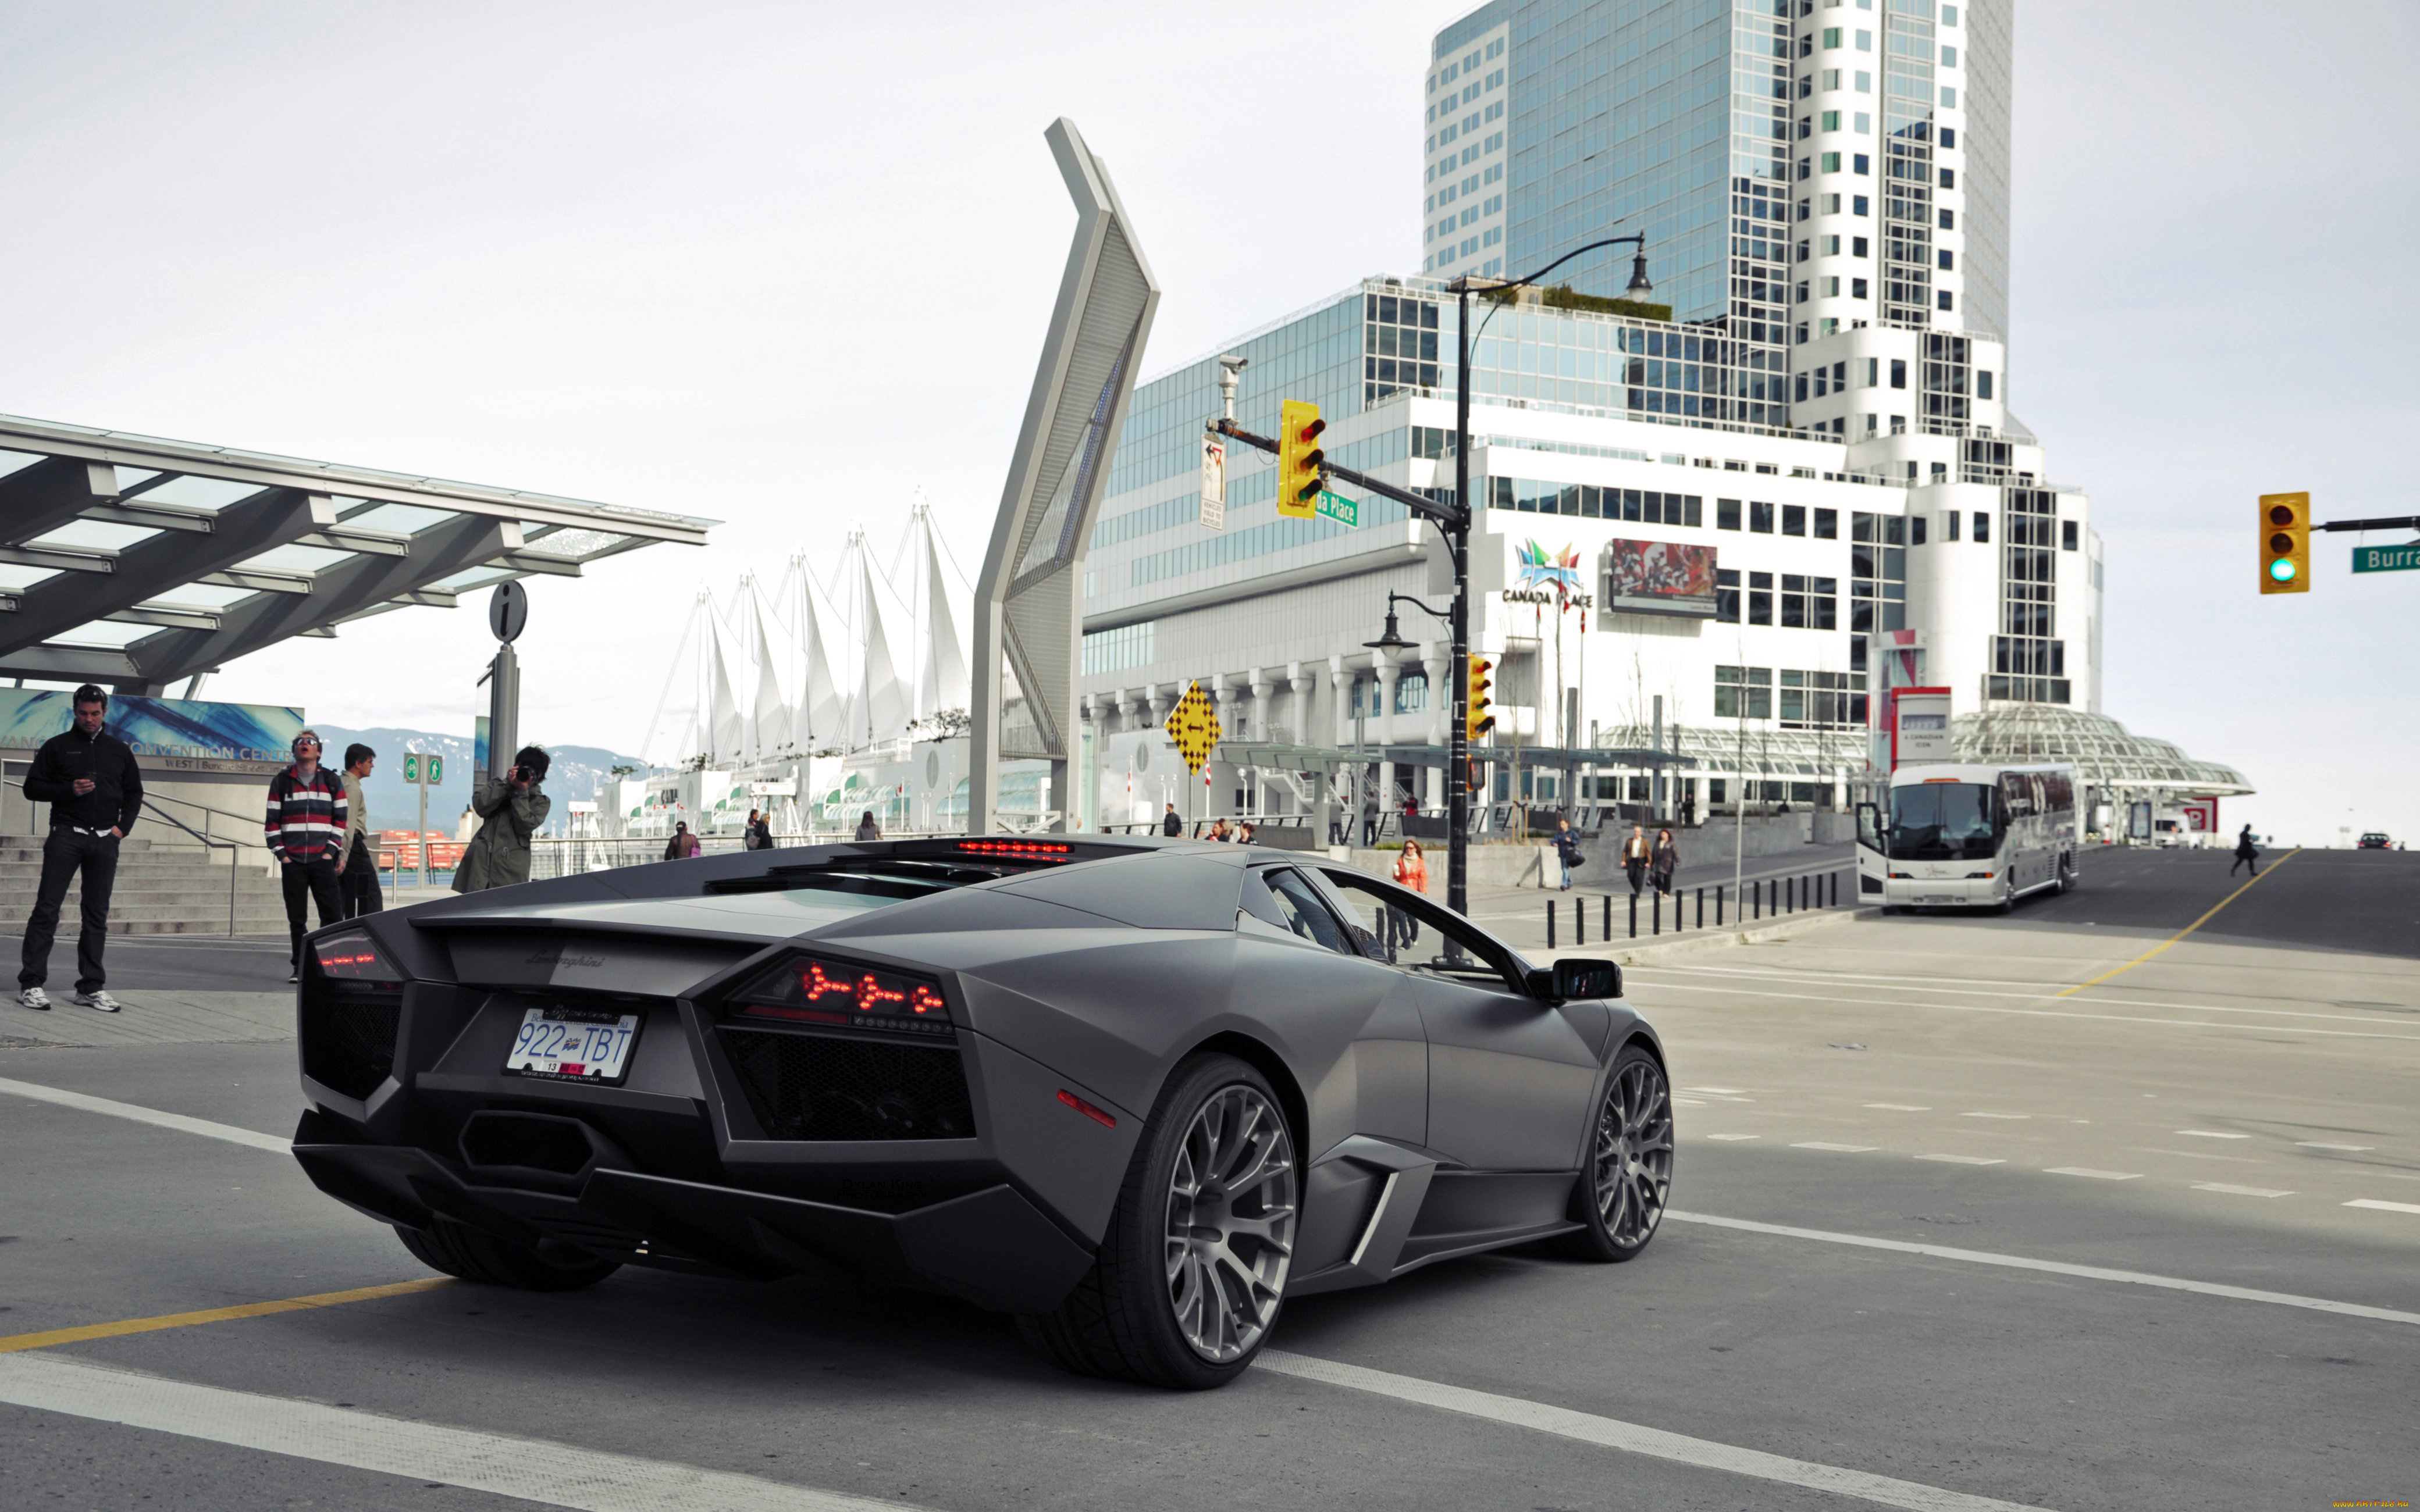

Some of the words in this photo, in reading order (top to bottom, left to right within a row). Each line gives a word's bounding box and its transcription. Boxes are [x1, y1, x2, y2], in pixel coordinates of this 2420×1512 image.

[1204, 501, 1222, 512] VEHICLES
[1204, 509, 1214, 518] YIELD
[1330, 496, 1354, 522] Place
[1202, 517, 1221, 527] BICYCLES
[1503, 590, 1551, 605] CANADA
[1556, 593, 1593, 608] PACE
[123, 740, 234, 759] ONVENTION
[240, 748, 294, 762] CENTR
[165, 758, 193, 769] WEST
[525, 948, 606, 968] Lamborghini
[515, 1023, 566, 1058] 922
[582, 1027, 632, 1063] TBT
[548, 1063, 557, 1071] 13
